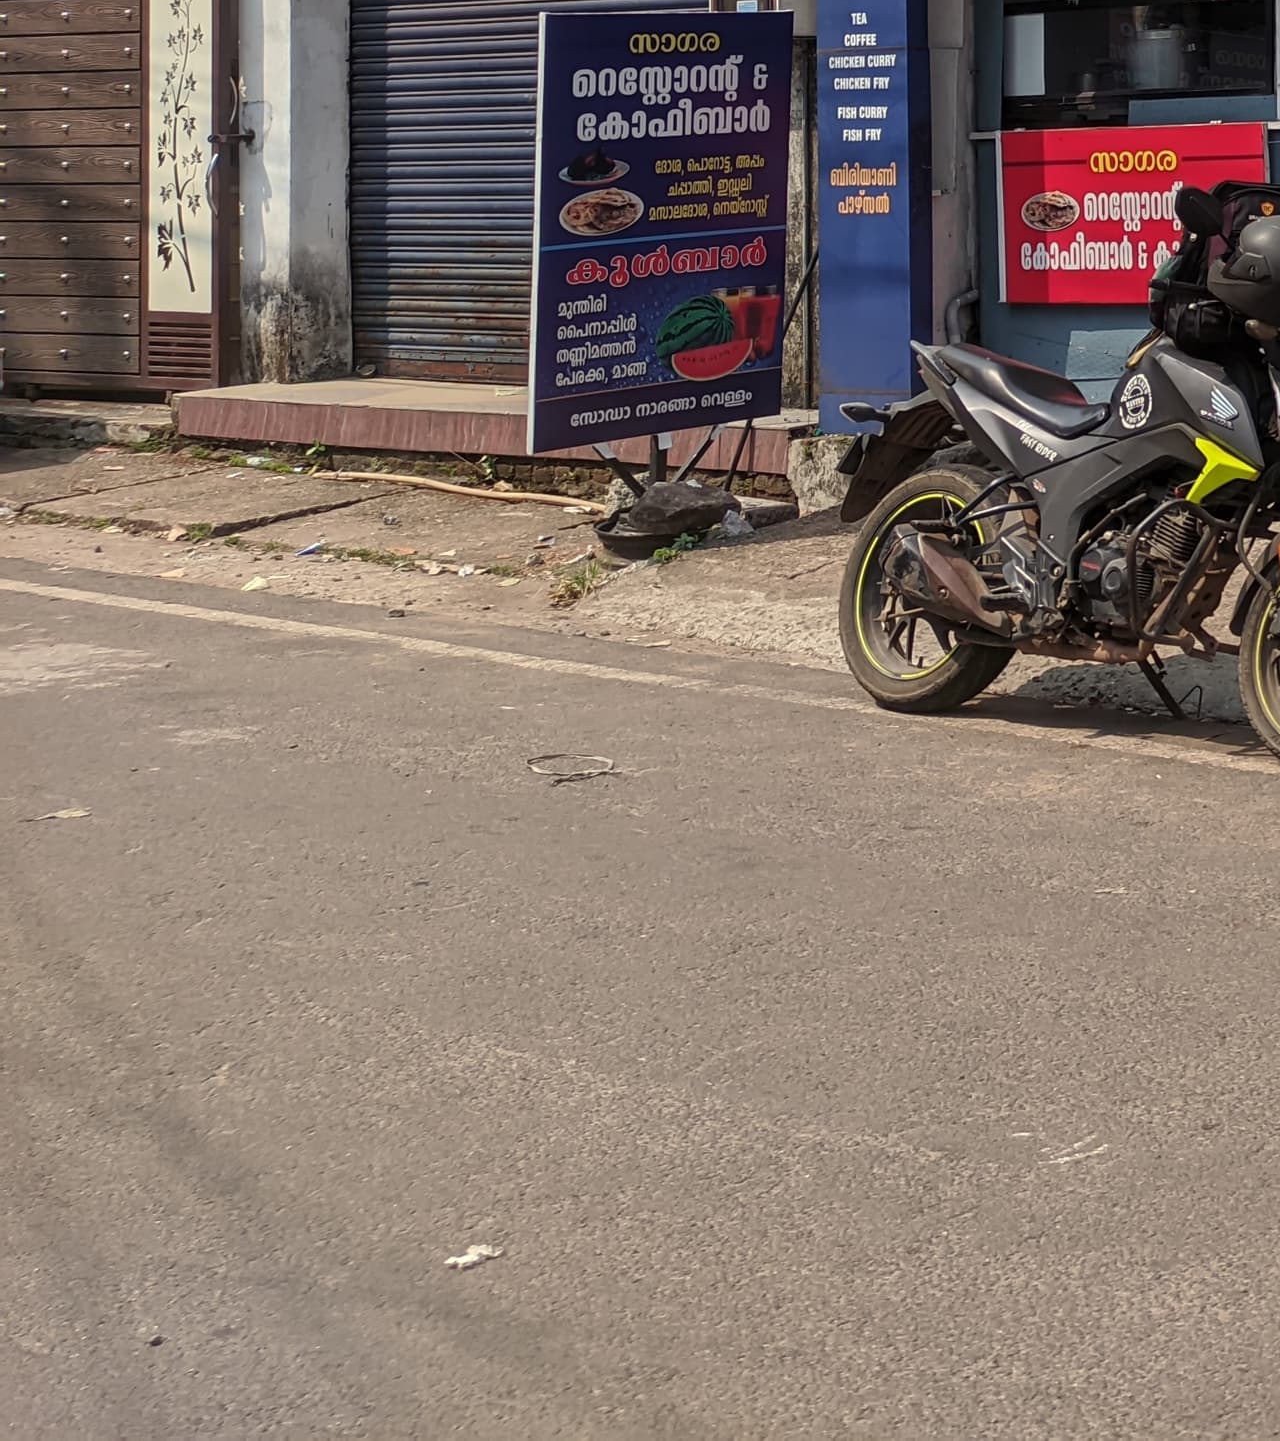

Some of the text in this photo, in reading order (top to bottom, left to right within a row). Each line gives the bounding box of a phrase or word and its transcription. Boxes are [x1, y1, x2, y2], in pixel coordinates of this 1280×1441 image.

[851, 12, 868, 25] TEA
[629, 32, 720, 54] സാഗര
[844, 34, 877, 47] COFFEE
[828, 54, 897, 69] CHICKEN CURRY
[753, 63, 769, 90] &
[834, 76, 890, 91] CHICKEN FRY
[837, 106, 888, 119] FISH CURRY
[842, 128, 882, 142] FISH FRY
[1090, 149, 1178, 173] സാഗര
[830, 162, 897, 188] ബിരിയാണി
[1138, 241, 1148, 270] &
[701, 389, 753, 408] വെള്ളം
